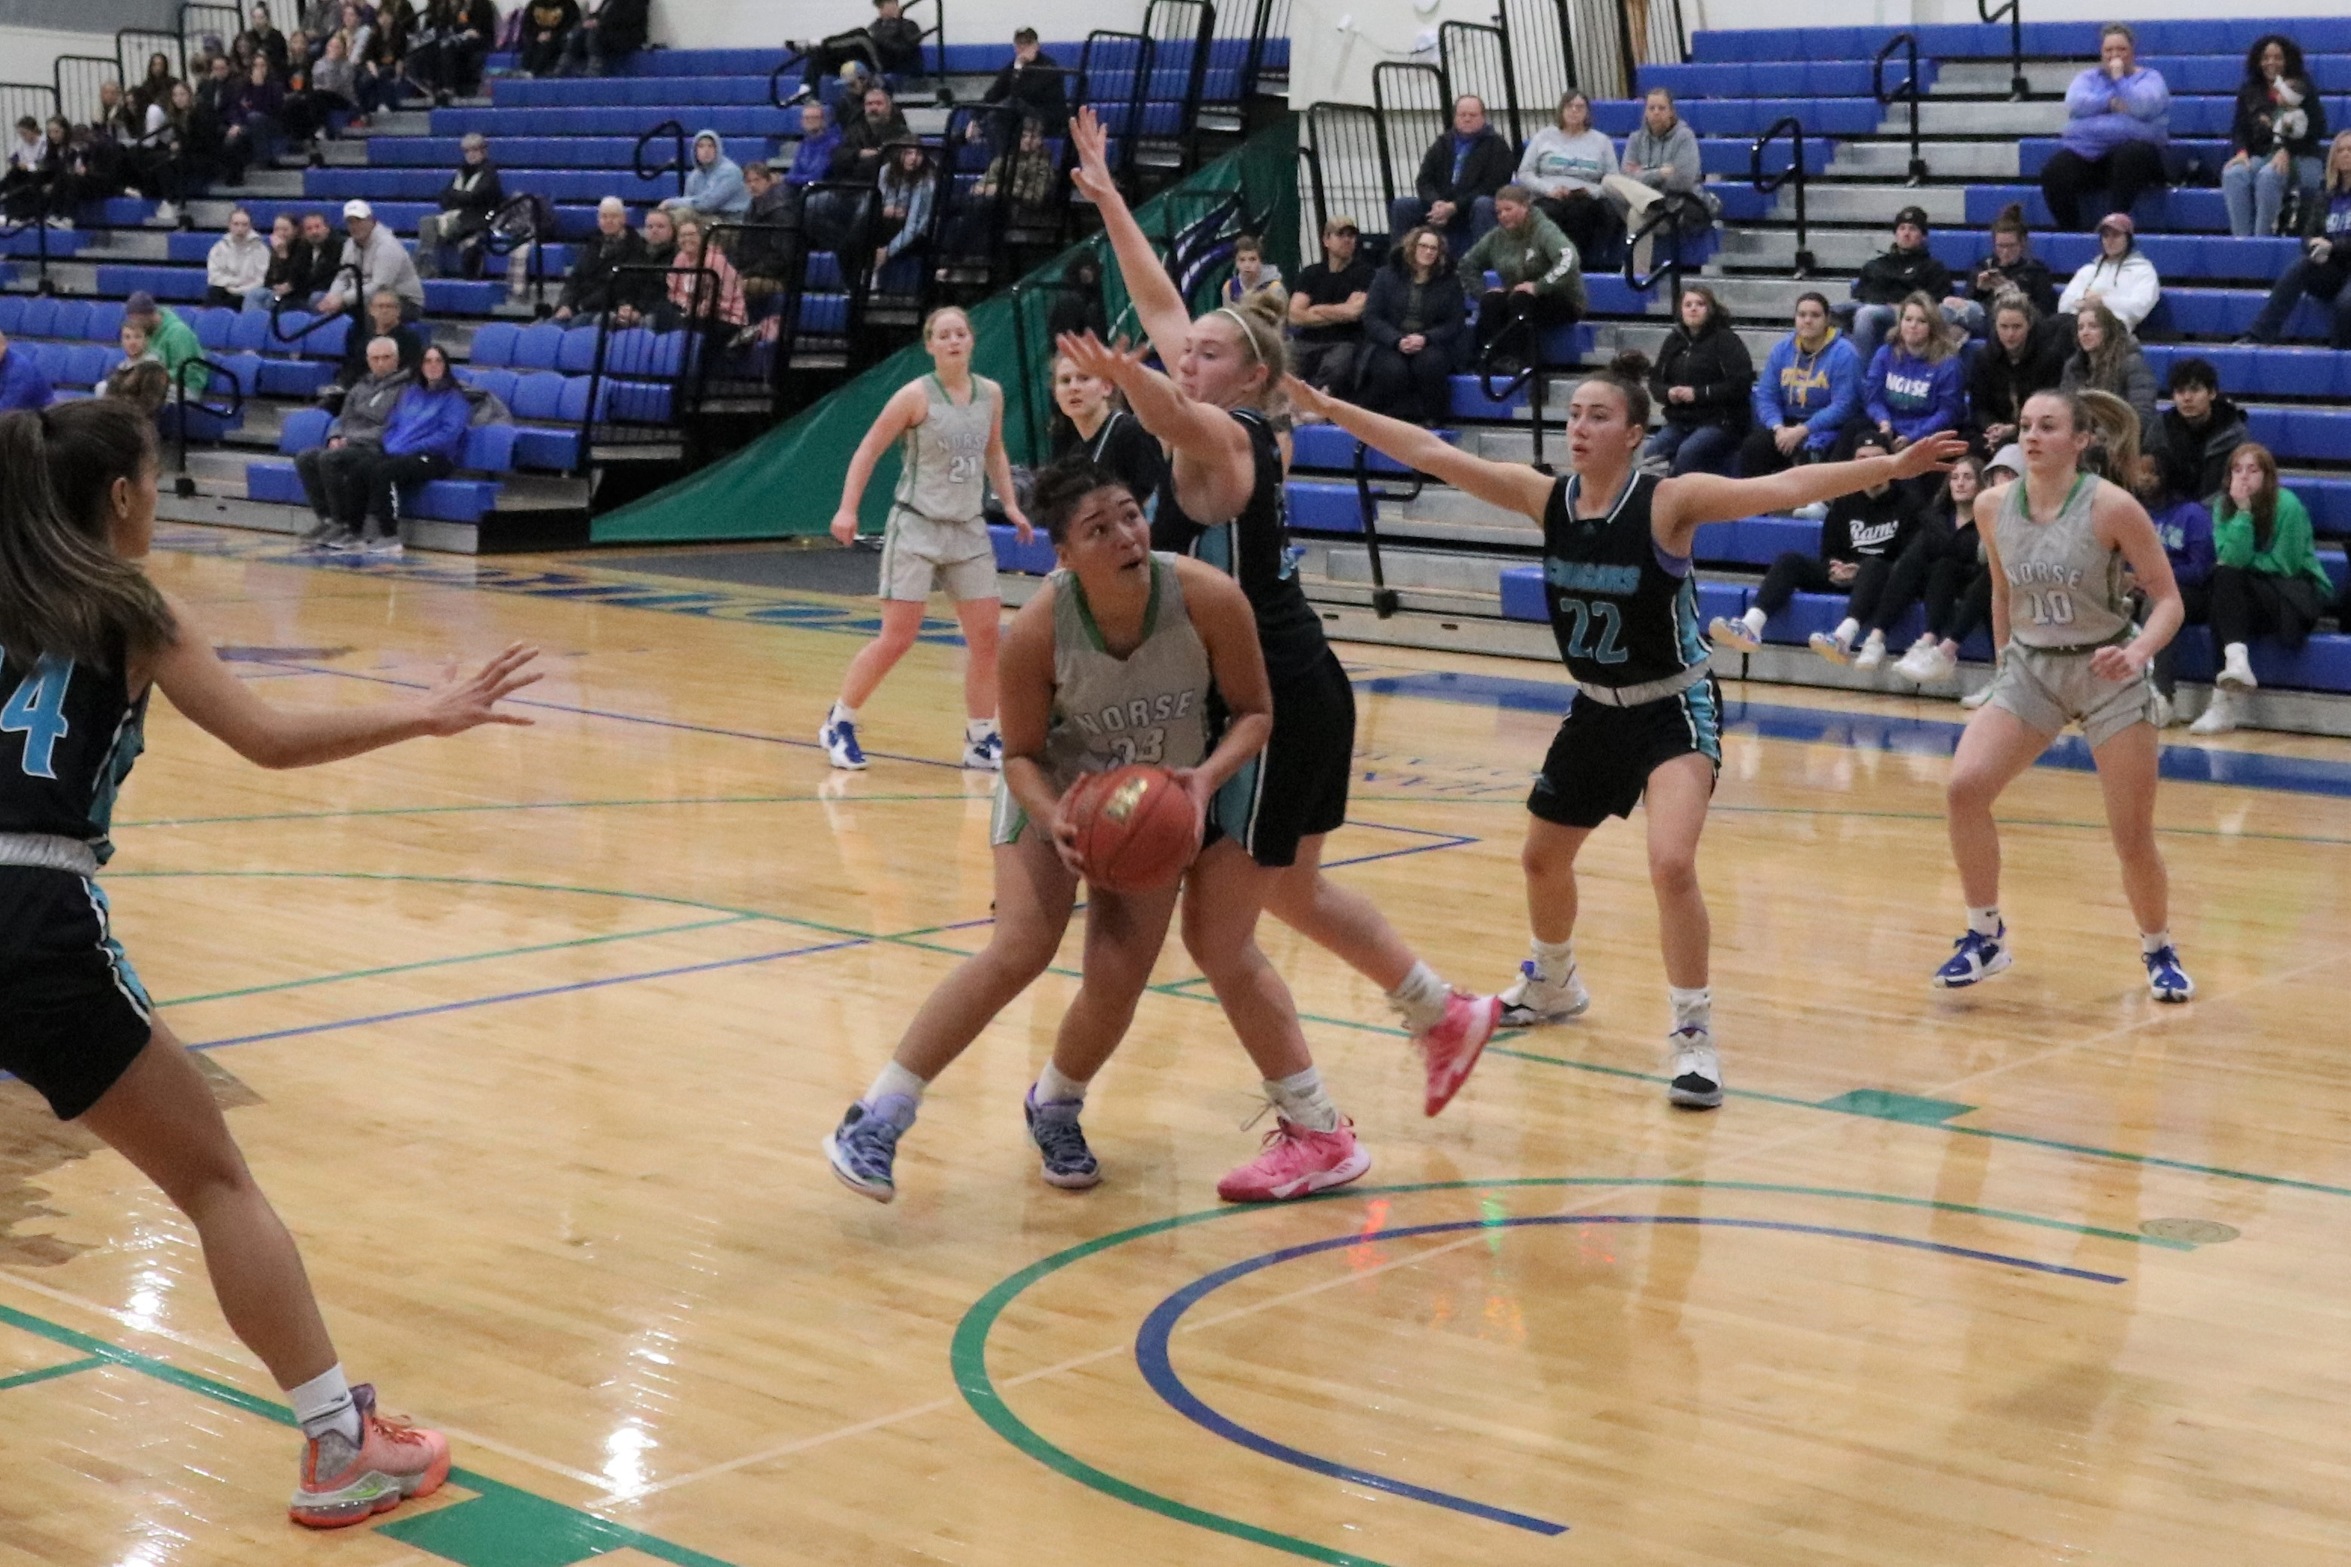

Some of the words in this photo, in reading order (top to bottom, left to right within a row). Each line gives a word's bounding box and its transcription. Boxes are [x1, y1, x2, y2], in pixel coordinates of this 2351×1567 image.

[937, 432, 985, 454] NORS
[949, 455, 977, 484] 21
[1849, 519, 1899, 548] Rams
[2005, 561, 2083, 590] NORSE
[2031, 589, 2074, 625] 10
[1560, 597, 1628, 664] 22
[0, 645, 75, 780] 4
[1073, 687, 1195, 735] NORSE
[1106, 727, 1165, 771] 23
